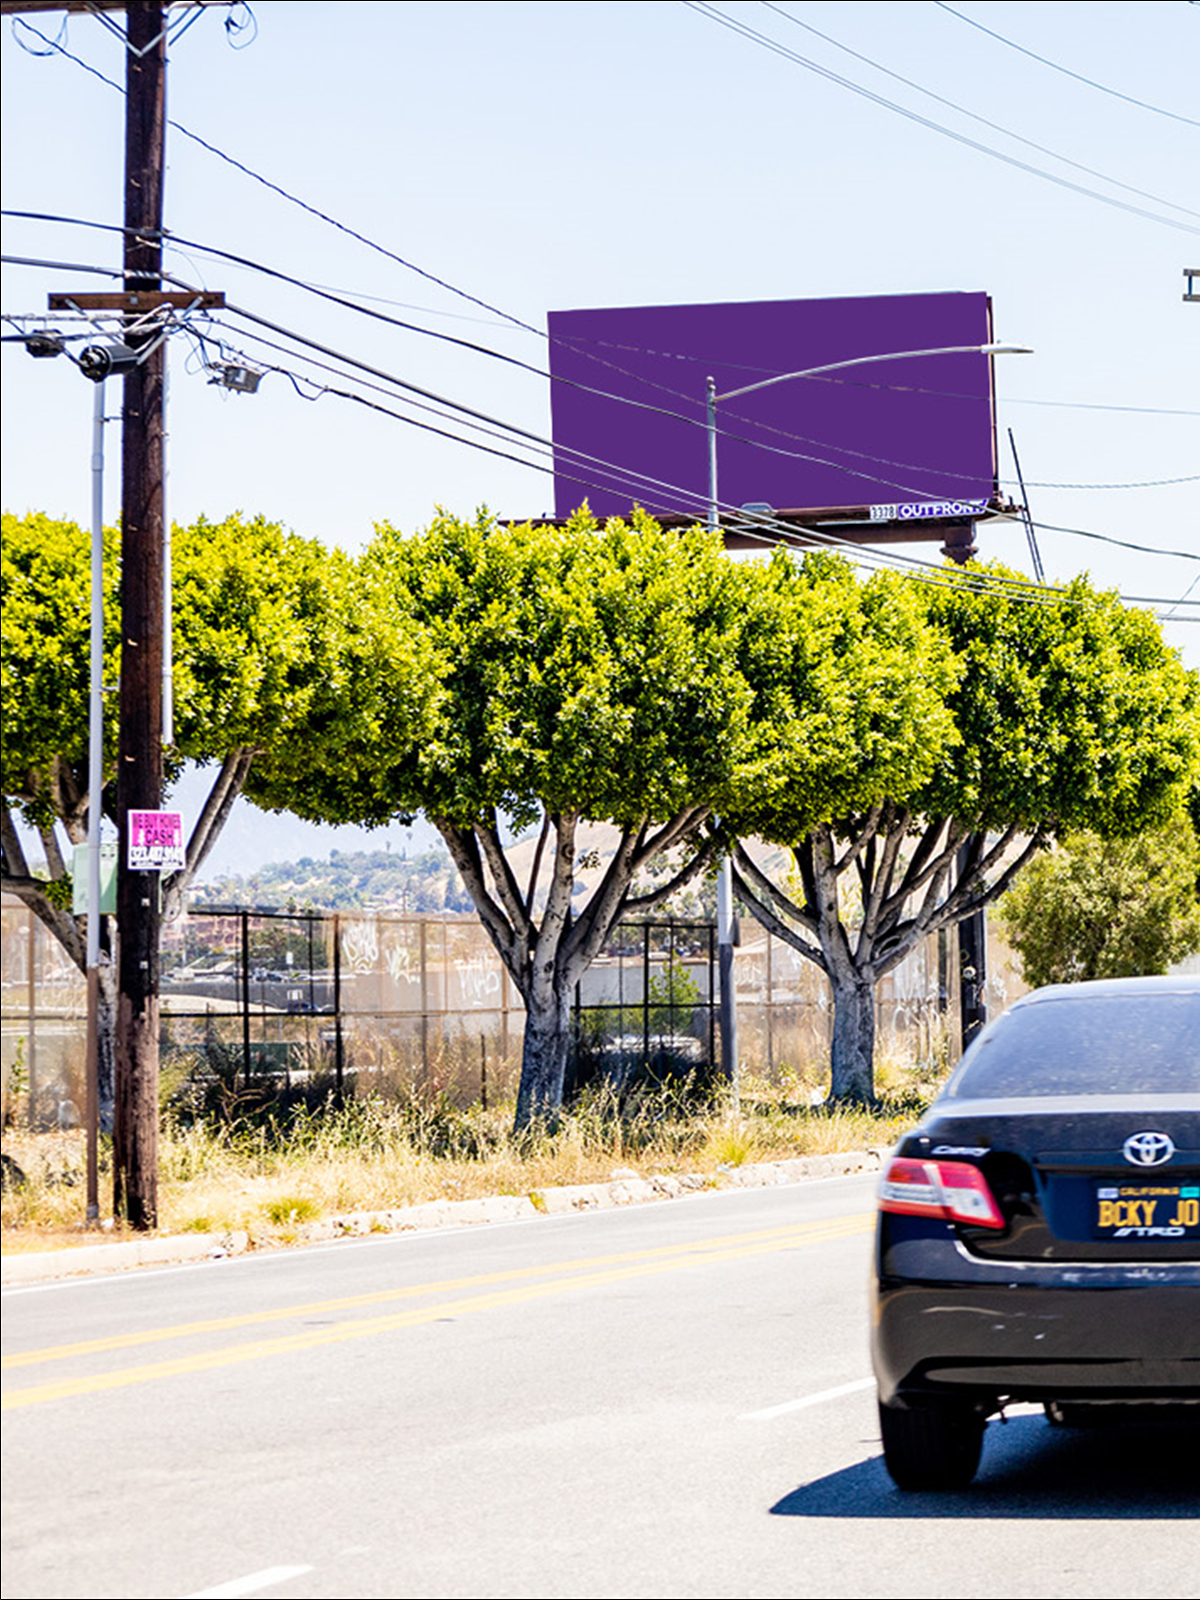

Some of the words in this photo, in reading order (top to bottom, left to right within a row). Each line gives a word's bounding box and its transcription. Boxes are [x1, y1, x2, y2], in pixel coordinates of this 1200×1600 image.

[145, 829, 174, 845] CASH
[1119, 1186, 1180, 1196] CALIFORNIA
[1098, 1200, 1157, 1227] BCKY
